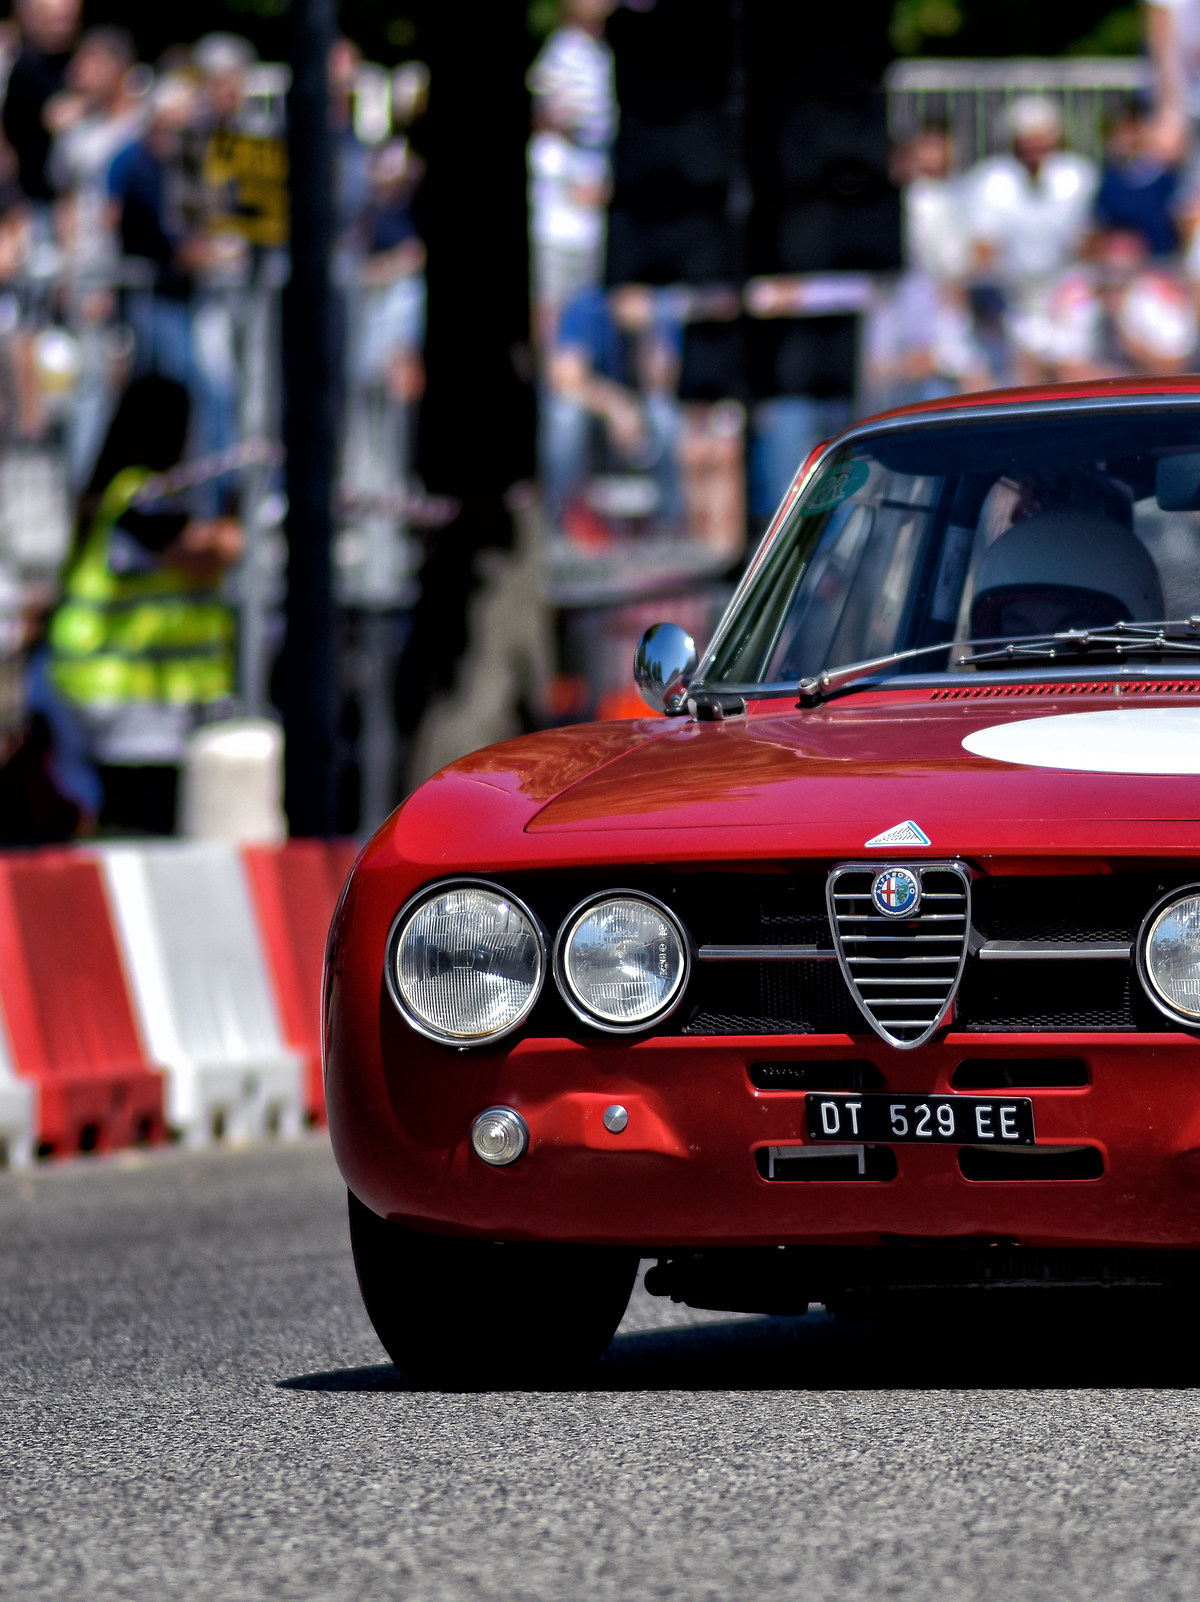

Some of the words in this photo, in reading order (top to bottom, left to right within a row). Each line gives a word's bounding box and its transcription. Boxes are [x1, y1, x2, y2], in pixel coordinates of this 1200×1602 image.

[820, 1101, 863, 1135] DT
[889, 1103, 956, 1136] 529
[975, 1105, 1020, 1139] EE
